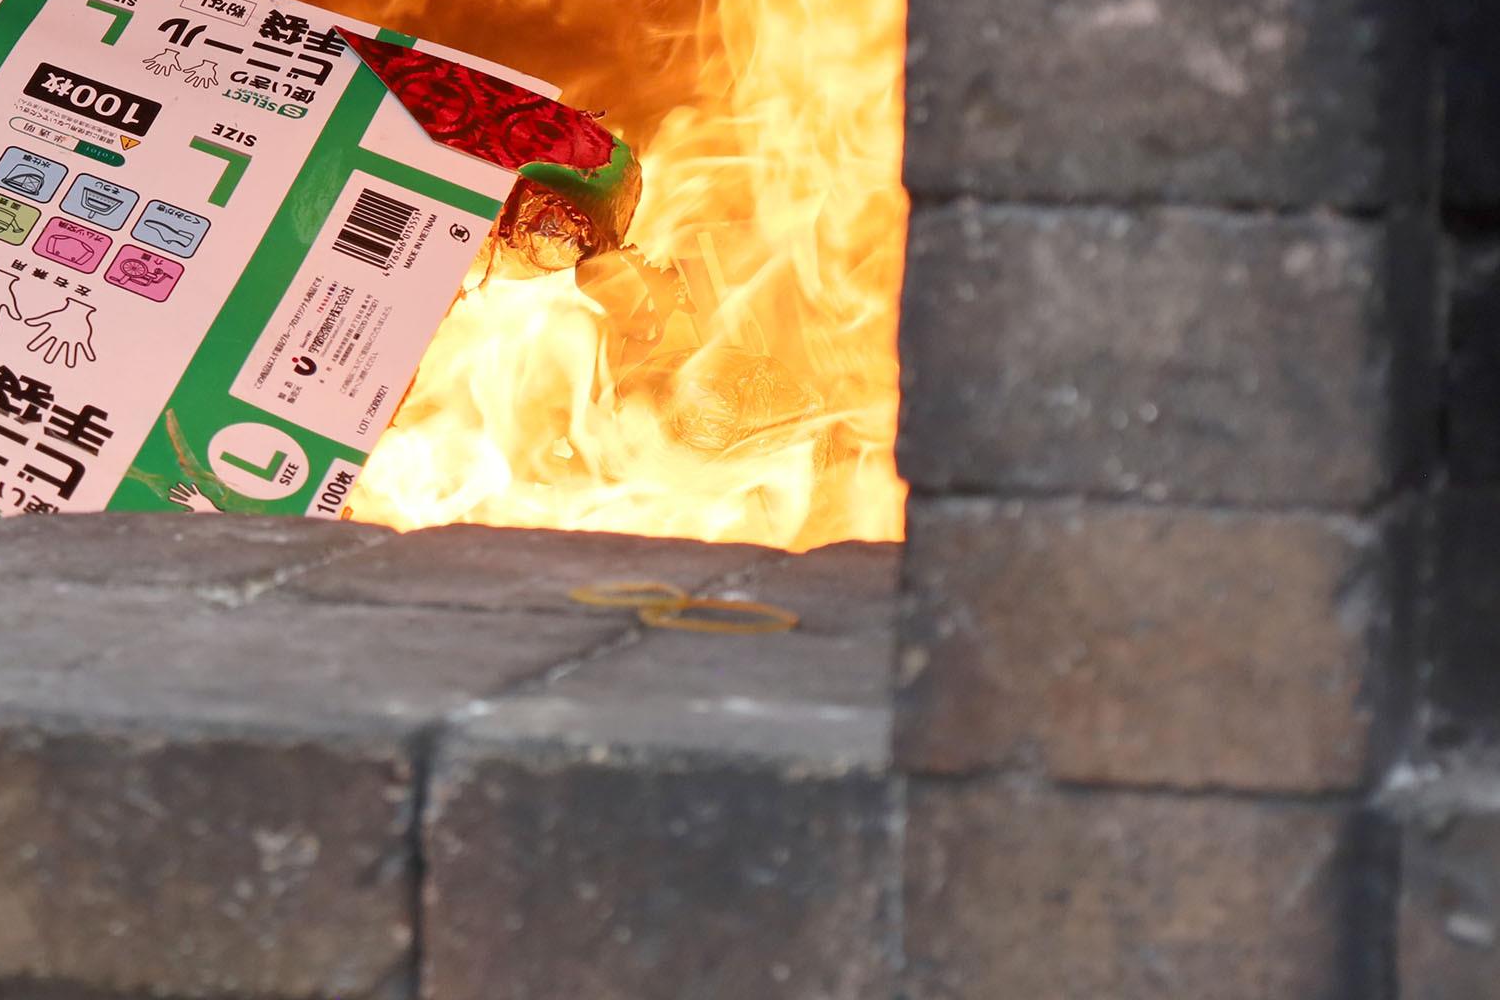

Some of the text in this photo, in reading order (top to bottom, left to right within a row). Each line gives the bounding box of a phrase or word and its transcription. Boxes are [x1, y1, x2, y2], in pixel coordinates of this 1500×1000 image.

[256, 5, 349, 59] 手袋
[154, 14, 333, 87] ビニール
[38, 70, 146, 128] 100枚
[221, 87, 277, 112] SELECT
[228, 67, 316, 105] 使いきり
[211, 122, 257, 147] SIZE
[22, 153, 51, 169] 水仕事
[188, 135, 252, 207] L
[93, 180, 121, 195] そうじ
[156, 202, 201, 225] くつみがき
[57, 220, 104, 243] オムツ交換
[404, 251, 418, 269] MADE
[419, 214, 438, 244] VIETNAM
[356, 414, 372, 435] LOT:
[219, 450, 288, 482] L
[279, 463, 299, 486] SIZE
[317, 471, 356, 514] 100枚
